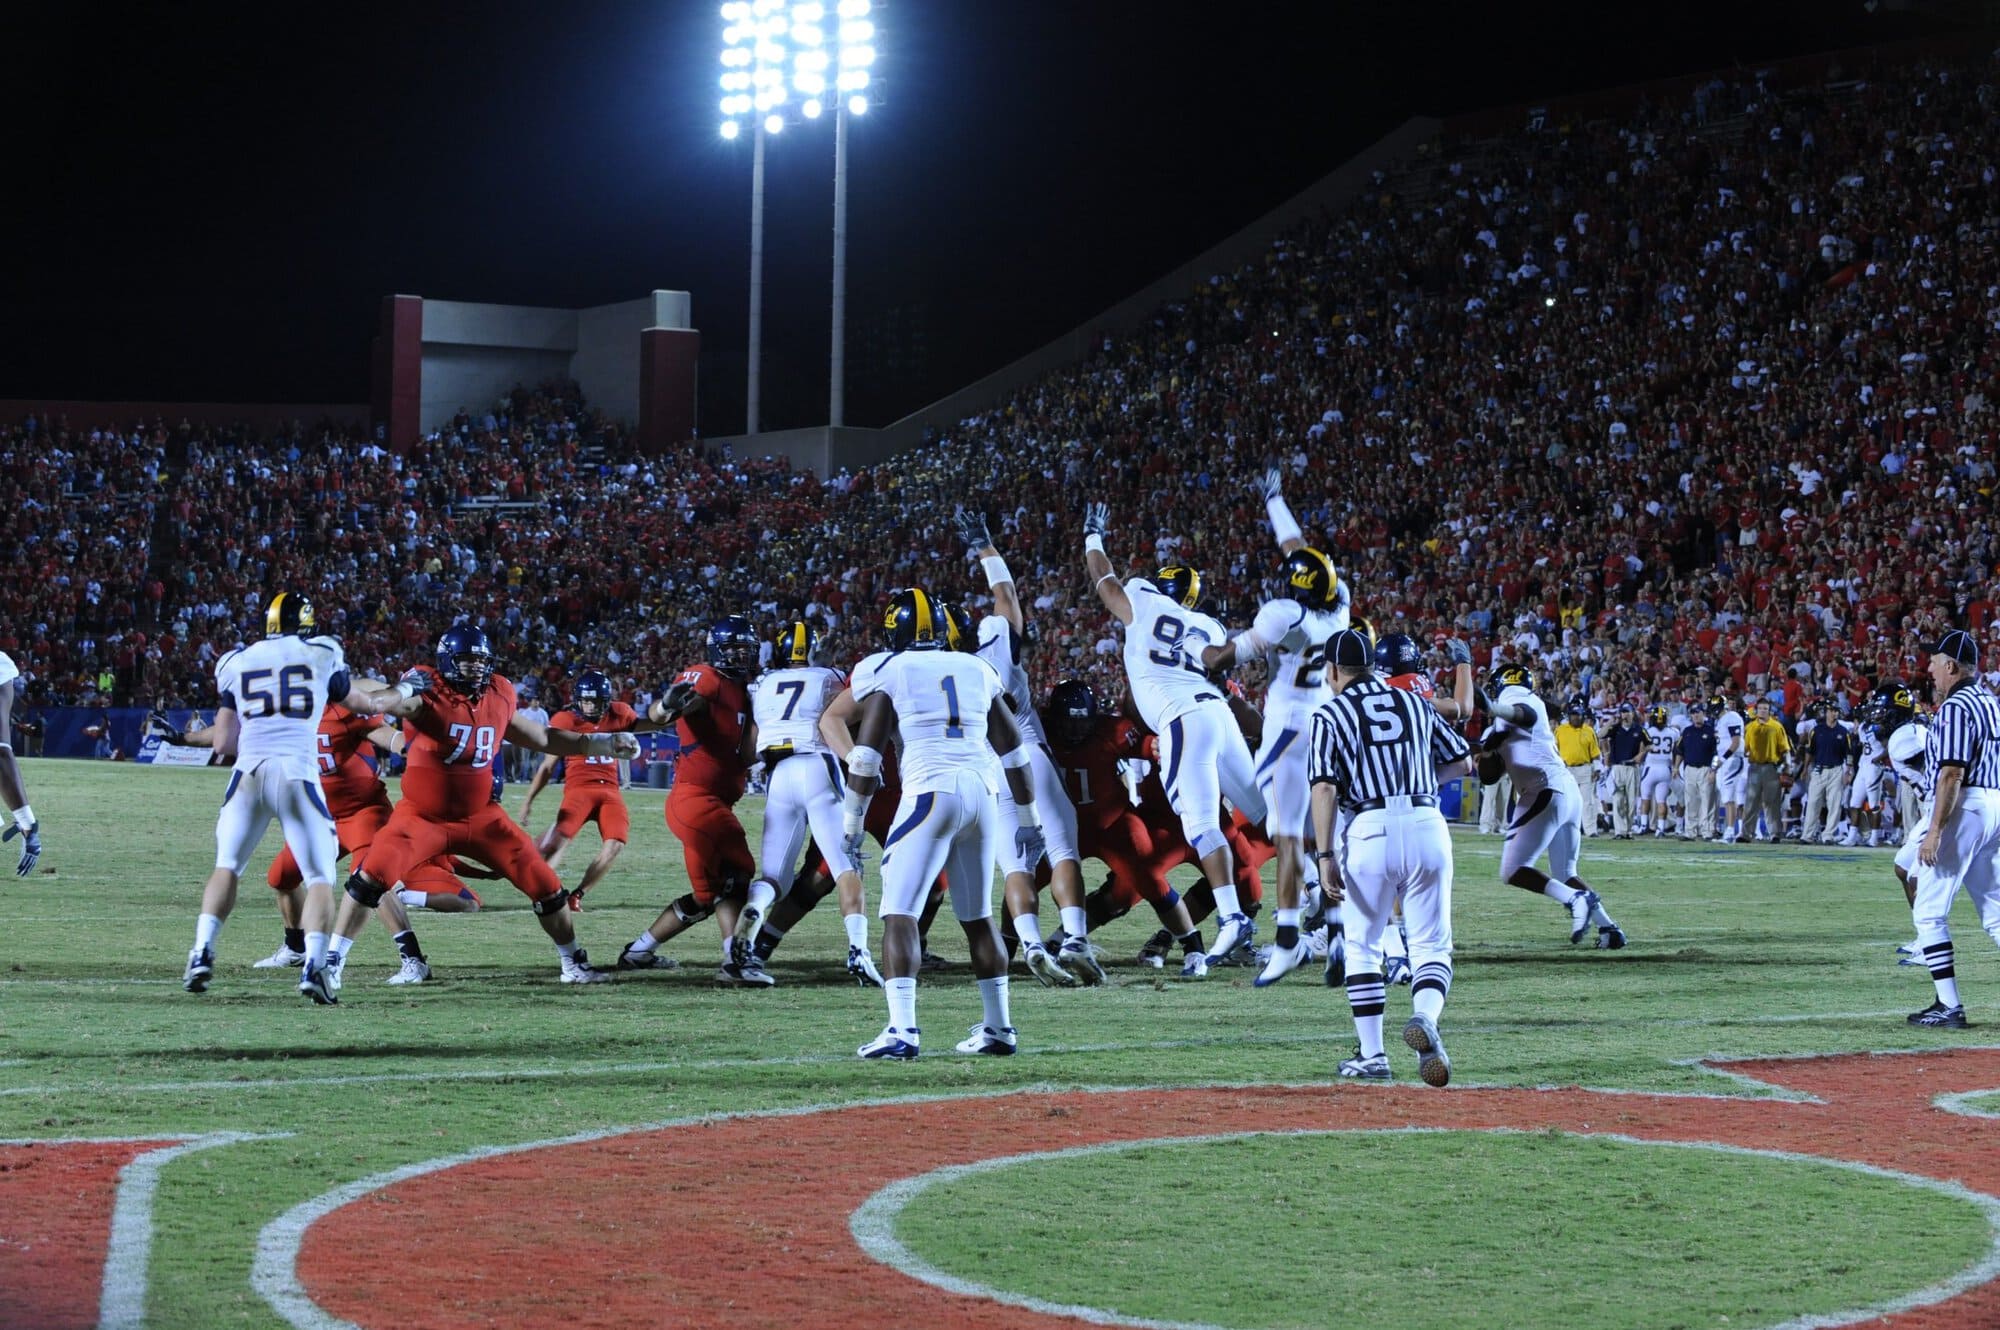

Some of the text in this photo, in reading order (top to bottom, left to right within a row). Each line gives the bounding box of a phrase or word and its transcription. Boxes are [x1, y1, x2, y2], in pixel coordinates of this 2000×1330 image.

[1290, 567, 1317, 589] Cal
[241, 664, 314, 720] 56
[1502, 668, 1522, 685] Cal
[776, 680, 805, 720] 7
[941, 675, 964, 738] 1
[1362, 694, 1404, 742] S
[1893, 689, 1912, 708] Cal
[443, 723, 496, 769] 78
[1650, 736, 1673, 754] 23
